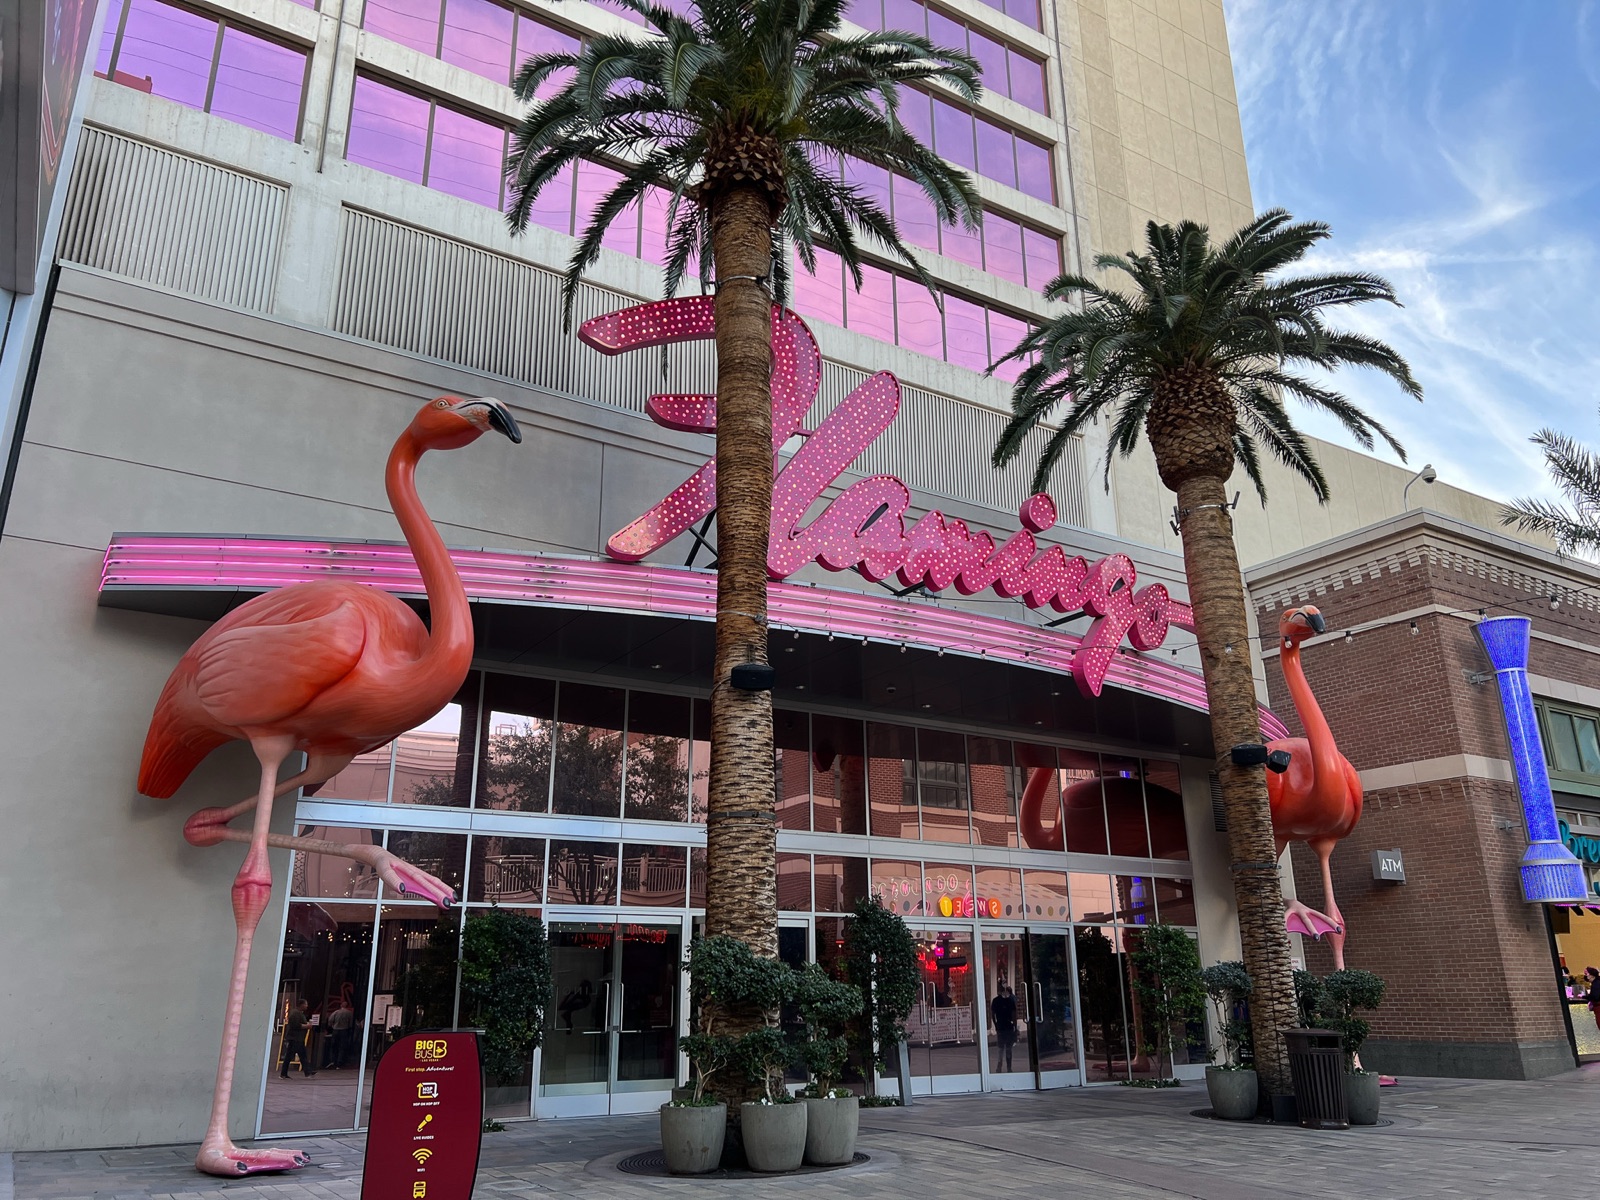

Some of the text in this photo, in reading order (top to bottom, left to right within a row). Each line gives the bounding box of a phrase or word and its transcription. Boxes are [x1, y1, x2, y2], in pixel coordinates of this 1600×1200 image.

[578, 295, 1194, 698] Flamingo
[1382, 858, 1402, 872] ATM
[416, 1040, 433, 1050] BIG
[415, 1050, 433, 1059] BUS
